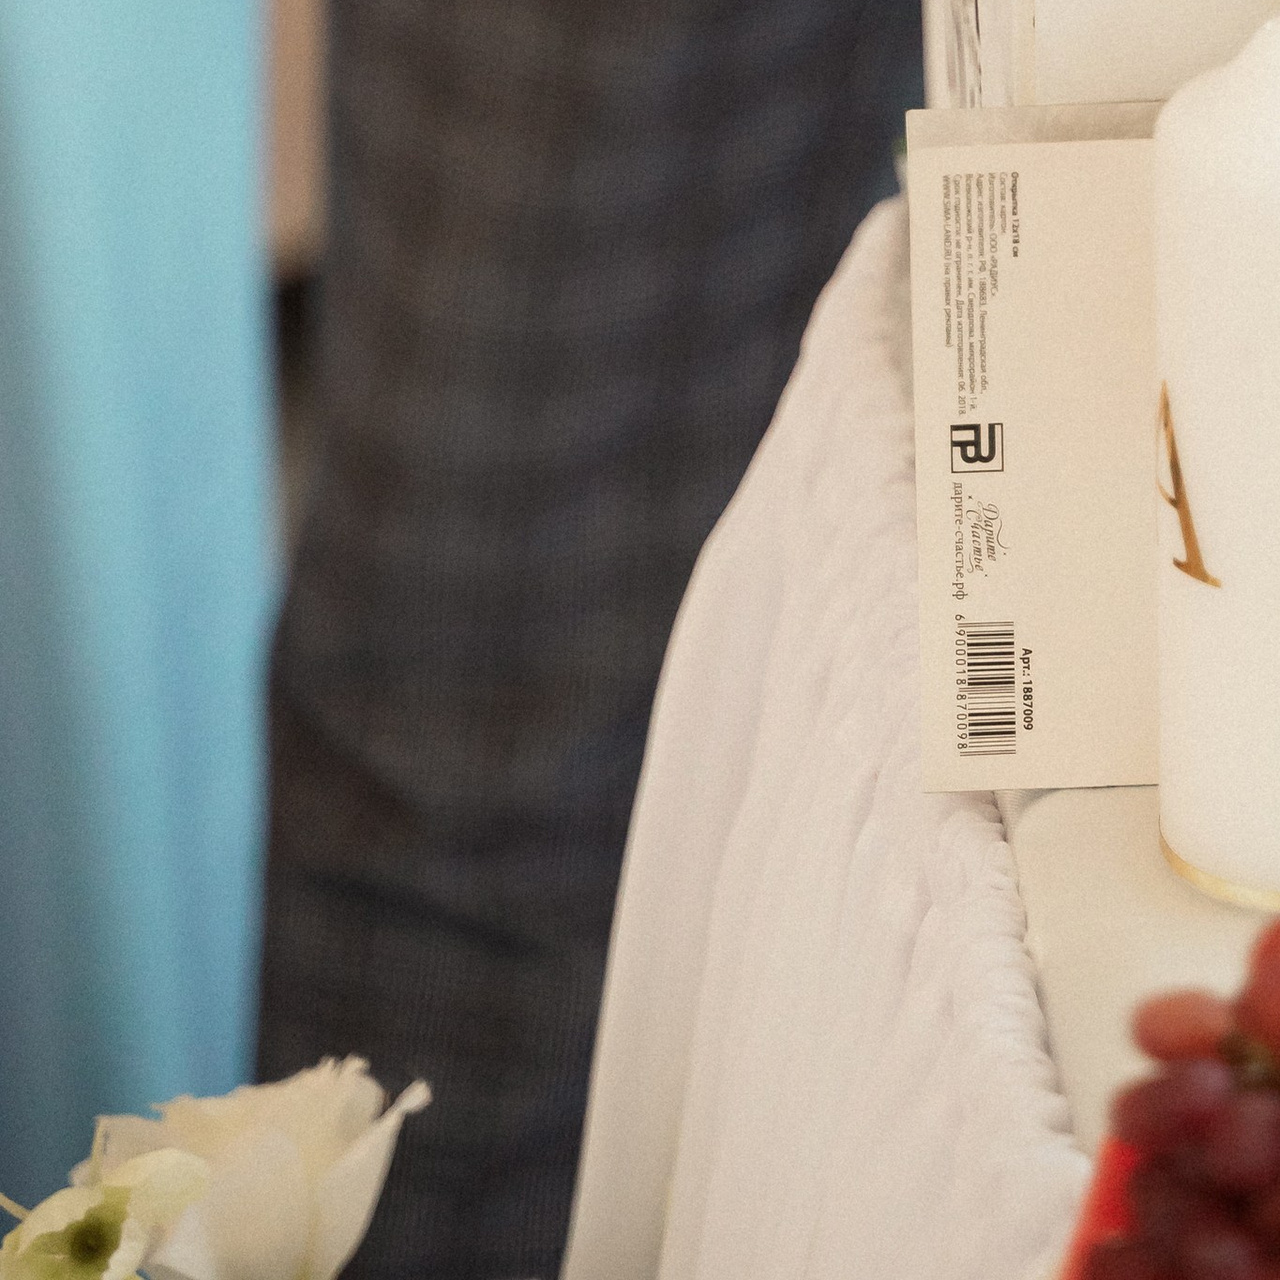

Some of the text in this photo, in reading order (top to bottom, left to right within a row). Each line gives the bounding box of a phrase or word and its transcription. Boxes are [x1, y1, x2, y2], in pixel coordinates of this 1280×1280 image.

[1010, 171, 1020, 216] Открытка
[951, 482, 969, 601] дарите-счастье.рф
[981, 503, 1000, 561] Дарите
[1019, 647, 1034, 731] Арт.: 1887009
